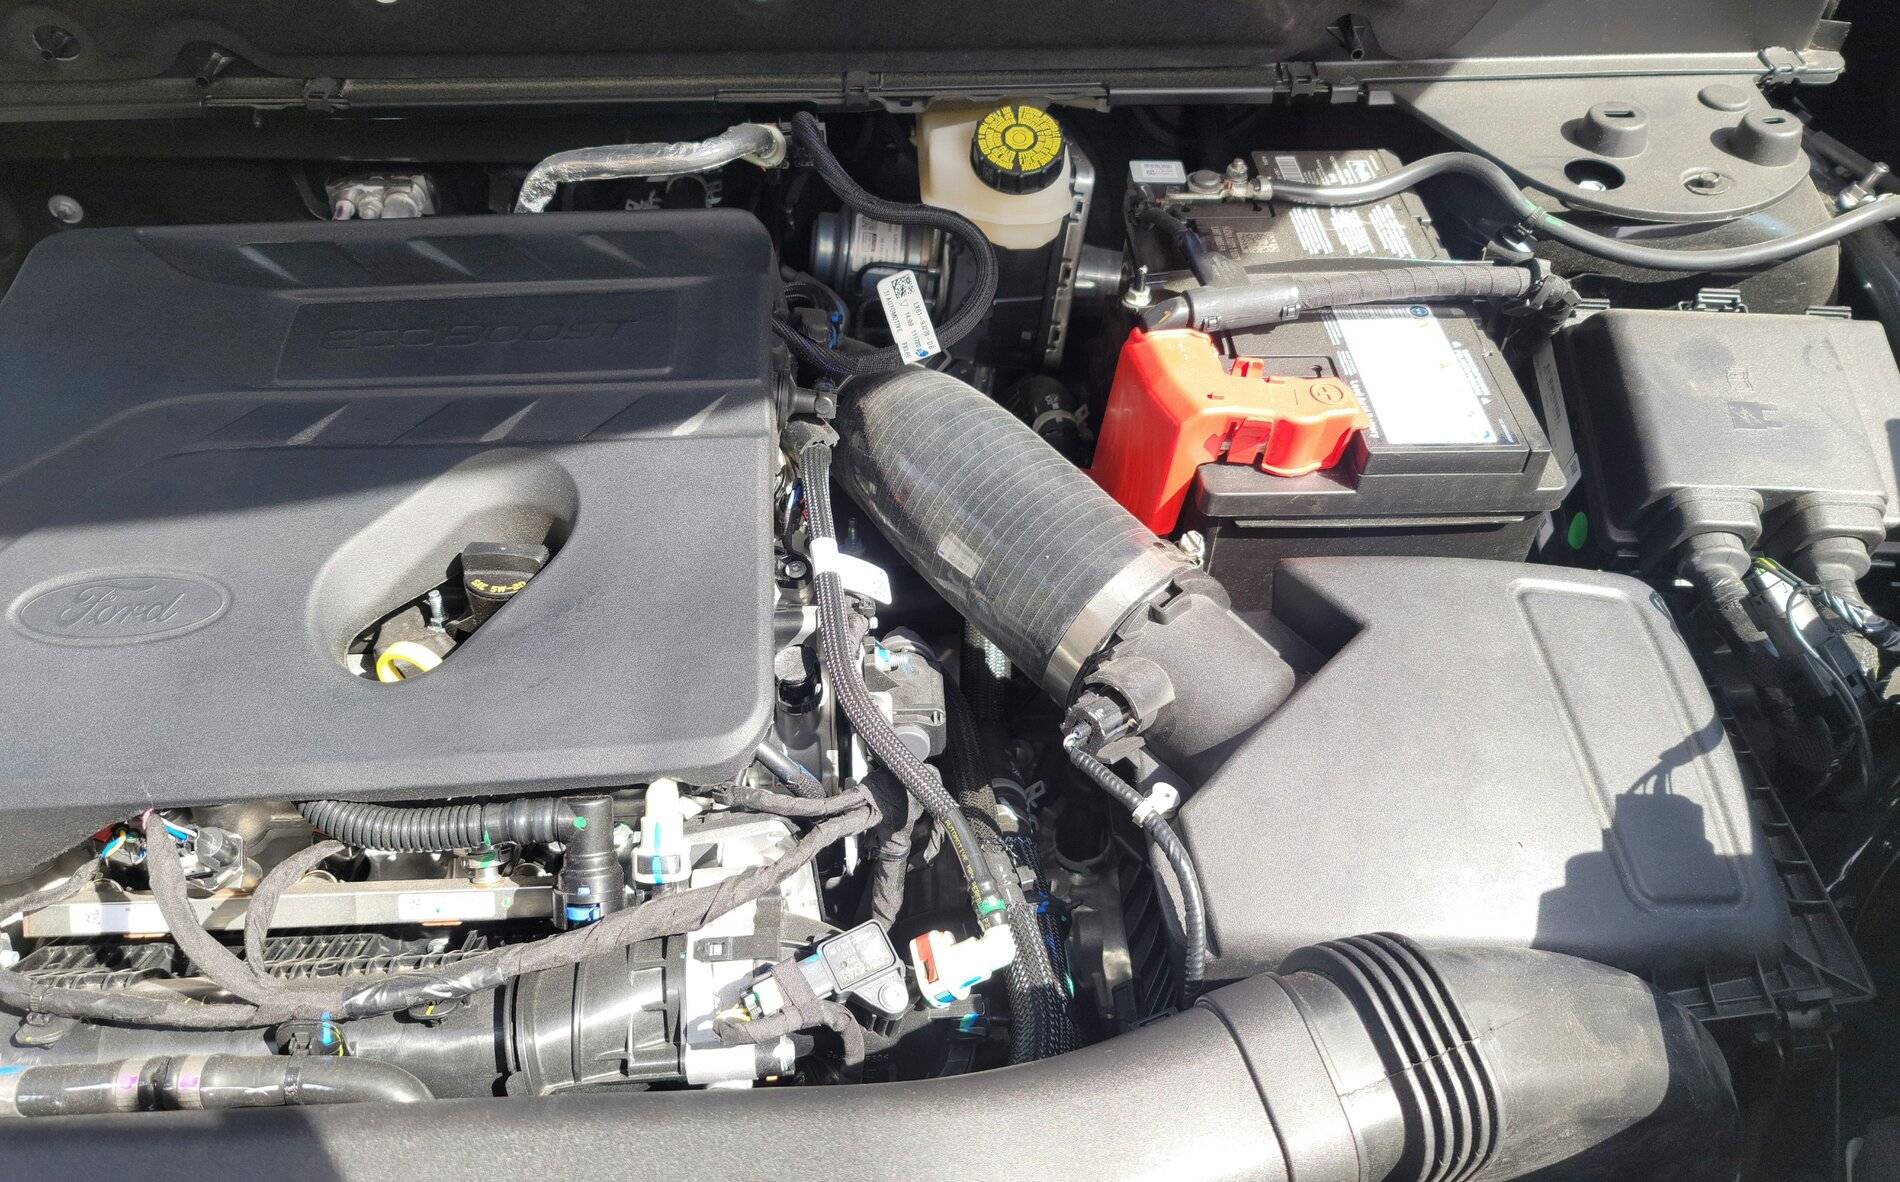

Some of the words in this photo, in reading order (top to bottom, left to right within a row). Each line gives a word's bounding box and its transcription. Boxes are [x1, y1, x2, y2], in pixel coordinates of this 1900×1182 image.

[322, 320, 642, 350] ECOBOOST
[55, 584, 186, 628] Ford
[944, 818, 969, 862] AUTOMOTIVE
